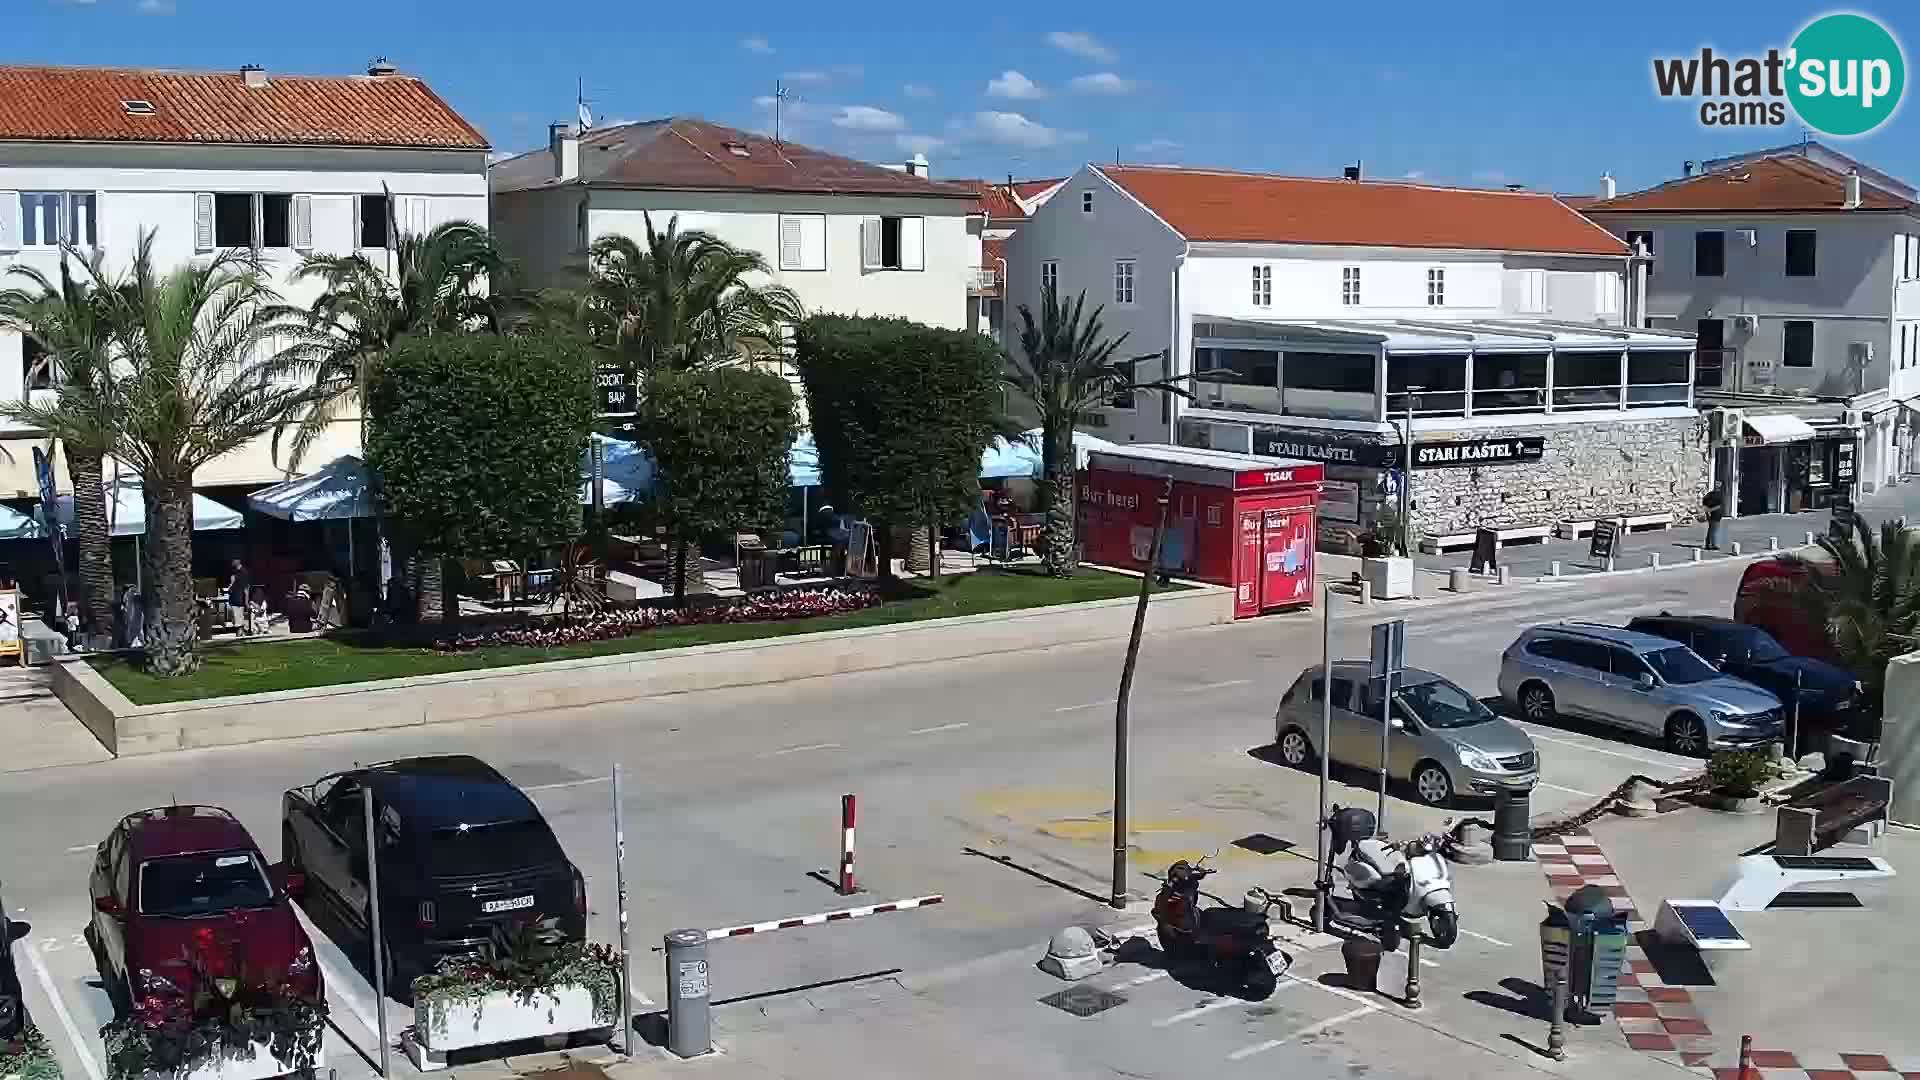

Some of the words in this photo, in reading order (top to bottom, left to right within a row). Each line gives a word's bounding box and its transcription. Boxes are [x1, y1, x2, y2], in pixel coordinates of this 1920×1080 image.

[1418, 447, 1459, 462] STARI
[1461, 442, 1512, 460] KAŠTEL
[1264, 470, 1294, 483] TISAK
